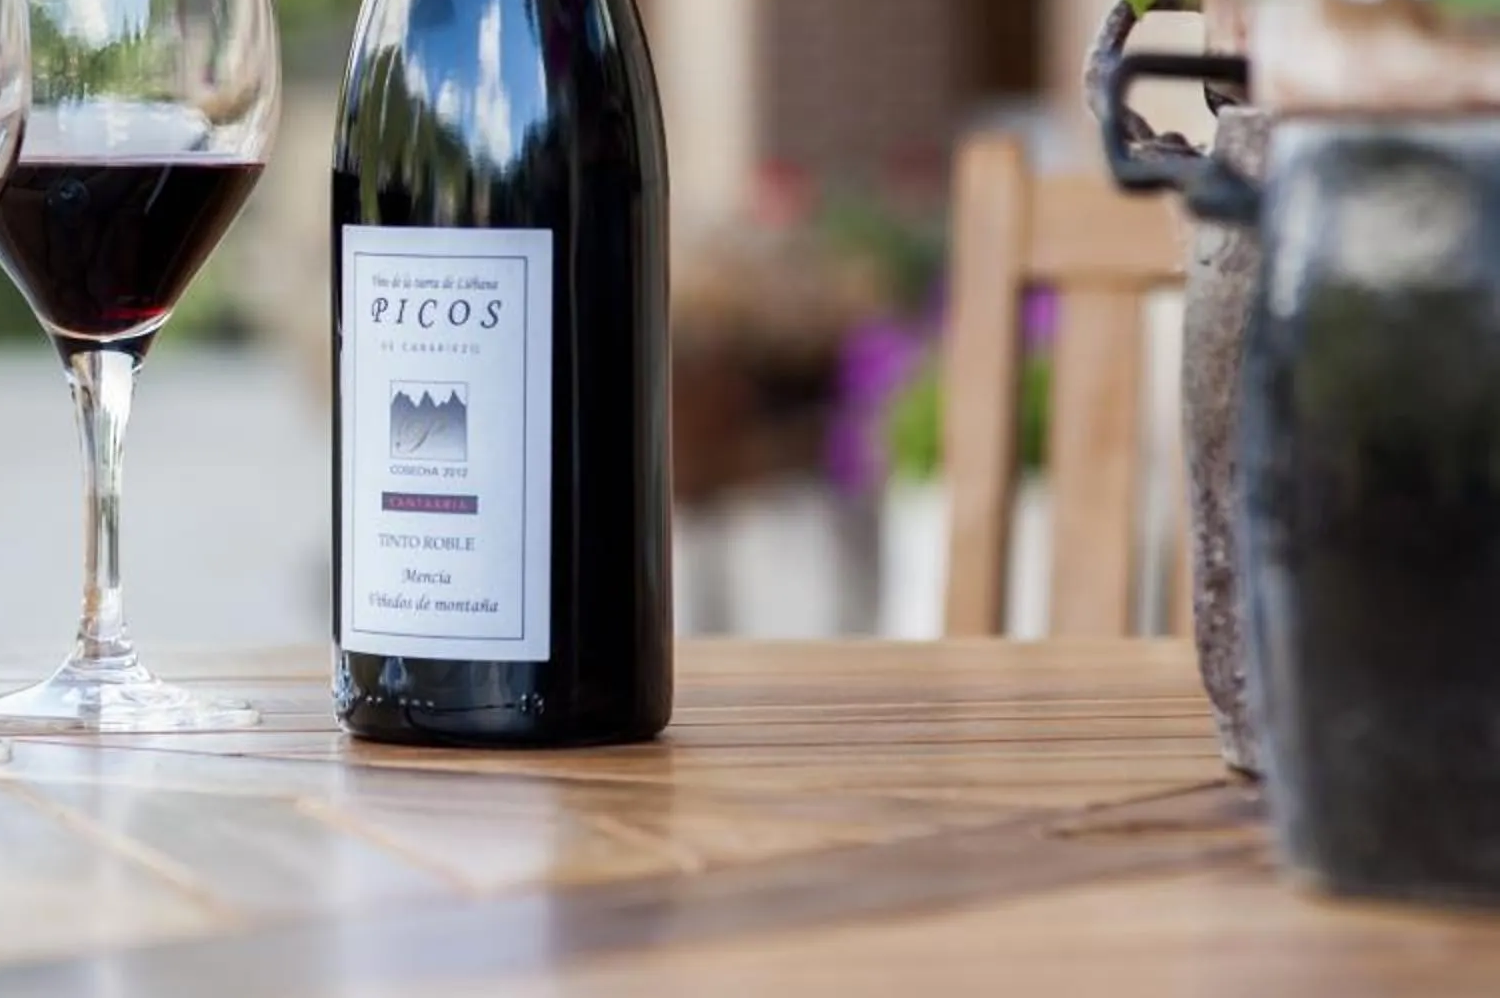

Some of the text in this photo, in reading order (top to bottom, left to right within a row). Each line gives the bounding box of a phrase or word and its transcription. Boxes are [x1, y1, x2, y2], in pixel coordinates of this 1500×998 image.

[371, 296, 503, 329] PICOS
[389, 465, 439, 477] COSECHA
[377, 533, 476, 552] TINTO ROBLE
[414, 593, 431, 613] de
[434, 597, 499, 614] montaña
